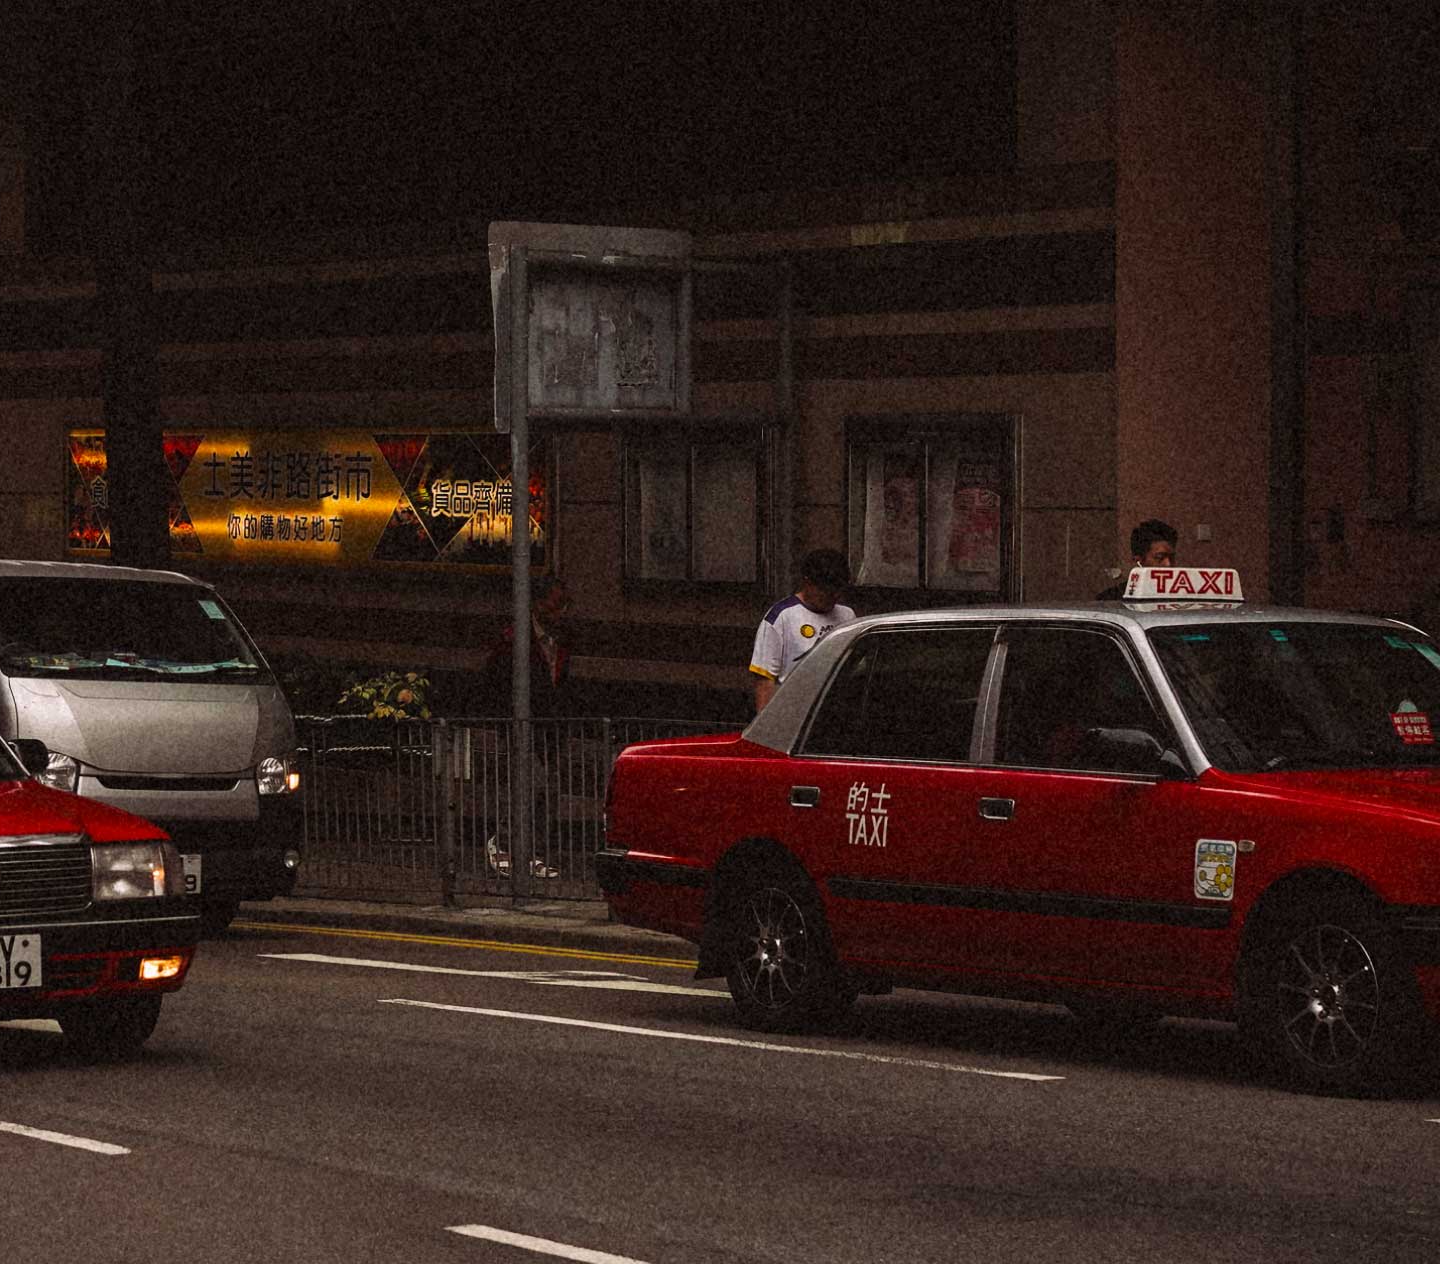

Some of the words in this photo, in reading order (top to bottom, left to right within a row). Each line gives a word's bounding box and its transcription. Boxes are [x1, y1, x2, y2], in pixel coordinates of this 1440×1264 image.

[203, 451, 372, 501] 士美非路街市
[228, 513, 344, 543] 你的購物好地方
[1151, 570, 1233, 594] TAXI
[846, 781, 891, 814] 的士
[845, 812, 888, 848] TAXI
